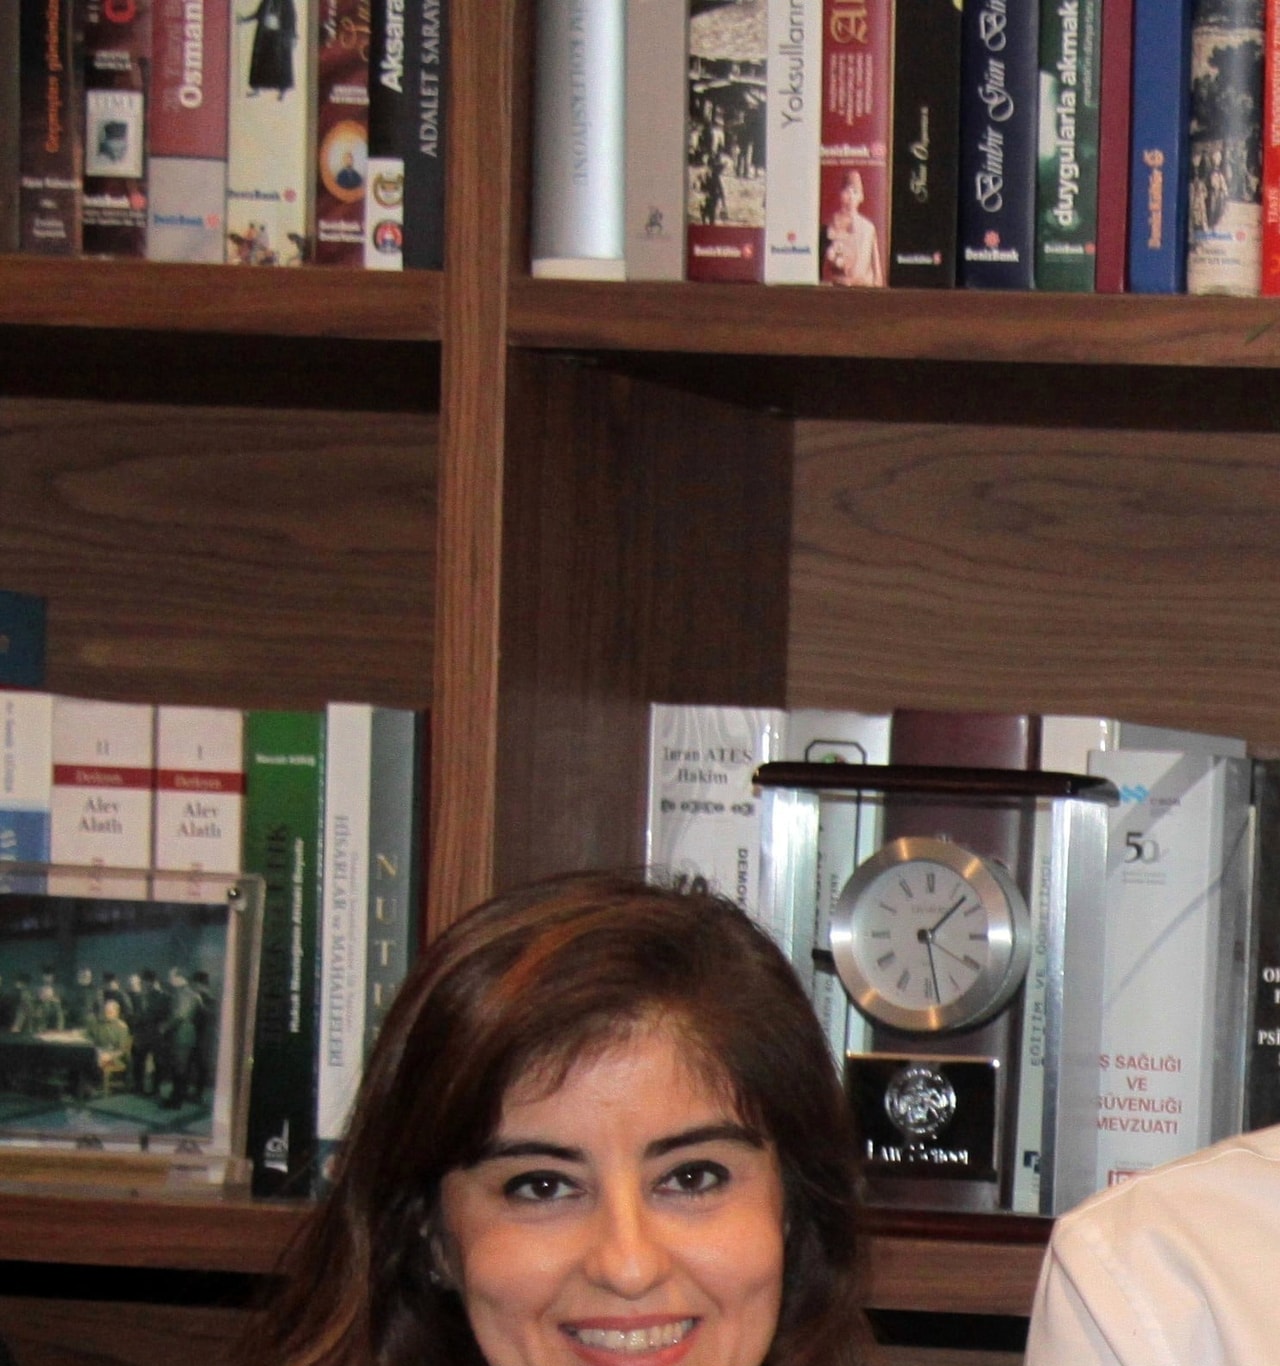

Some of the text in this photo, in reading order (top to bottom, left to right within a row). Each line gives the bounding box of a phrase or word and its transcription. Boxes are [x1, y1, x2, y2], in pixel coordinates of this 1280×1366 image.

[419, 69, 441, 158] ADALET
[1055, 92, 1080, 226] duygularla
[1123, 831, 1161, 865] 50
[1115, 1051, 1183, 1073] SAĞLIĞI
[1125, 1076, 1149, 1092] VE
[1097, 1116, 1180, 1137] MEVZUATI
